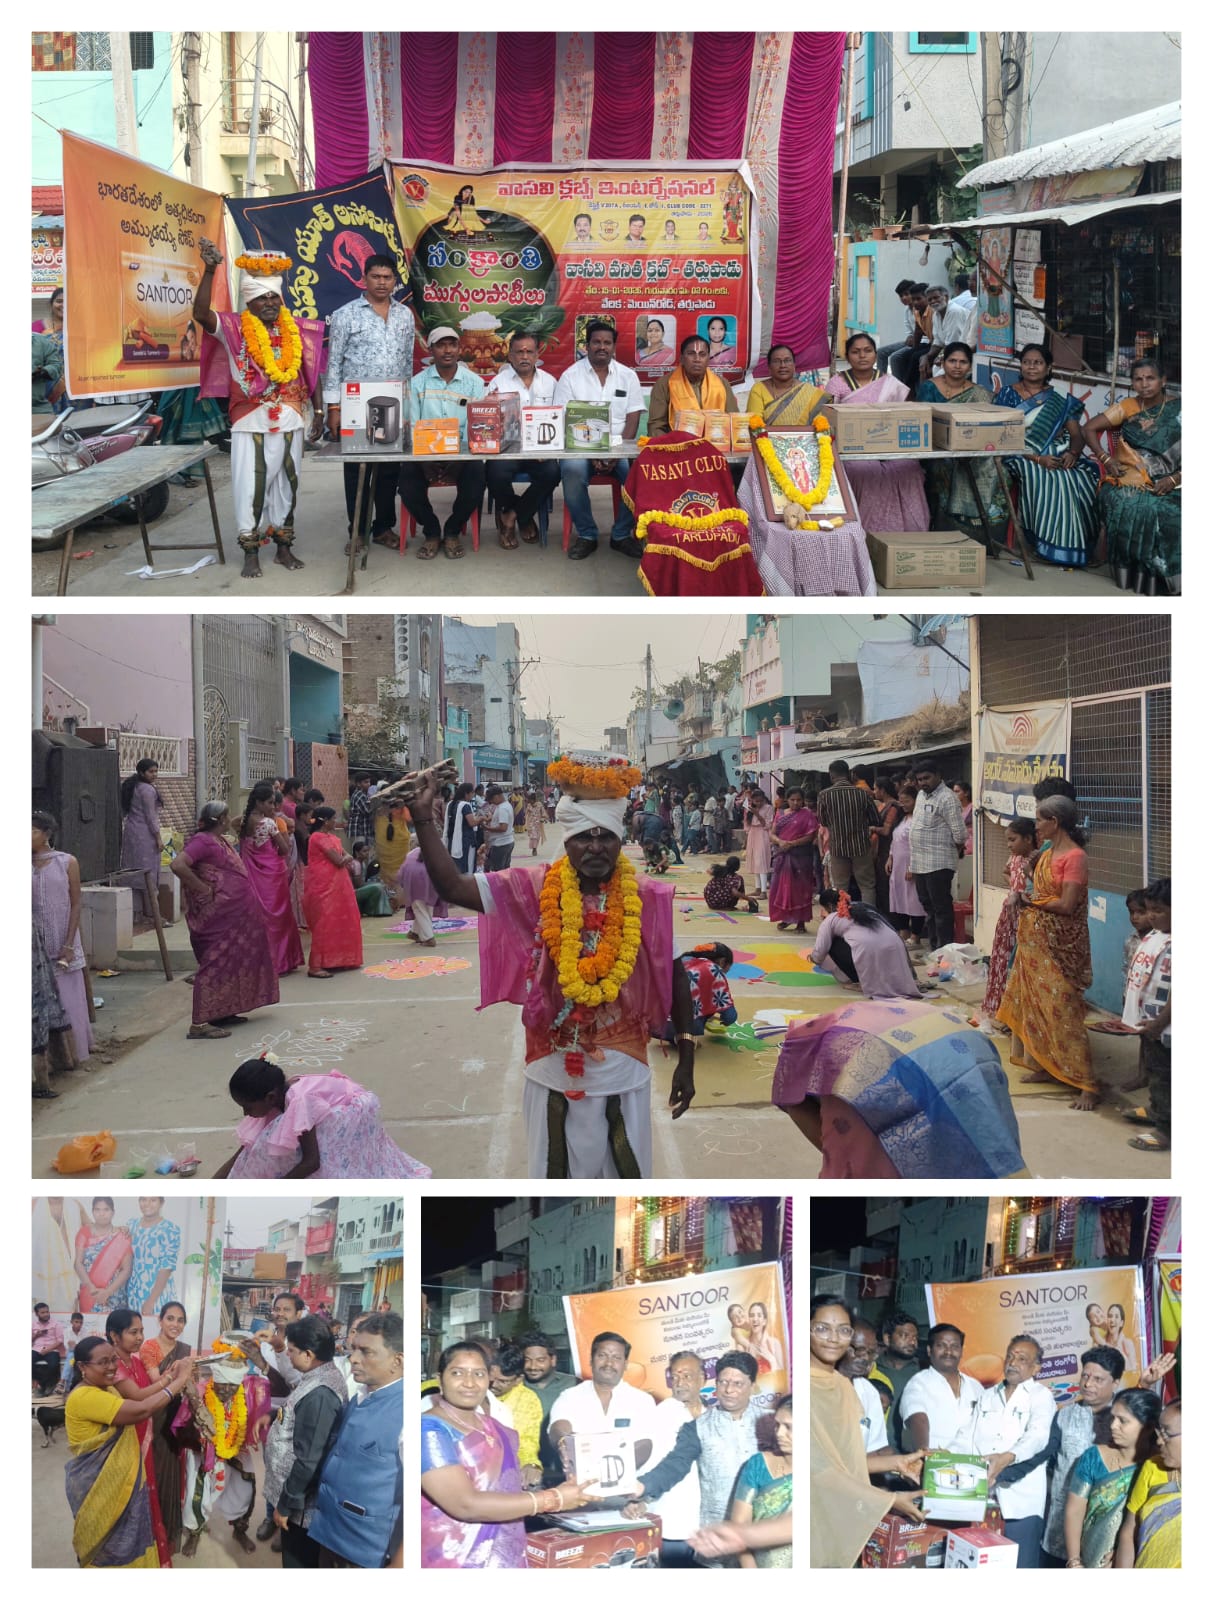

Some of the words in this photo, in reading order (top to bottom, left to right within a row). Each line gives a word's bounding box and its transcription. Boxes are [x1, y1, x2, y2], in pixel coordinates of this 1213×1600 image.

[497, 180, 555, 196] వాసవి
[558, 177, 594, 201] క్లబ్స్
[597, 176, 716, 201] ఇంటర్నేషనల్
[97, 181, 162, 212] భారతదేశంలో
[165, 202, 206, 226] అత్యధికంగా
[120, 218, 177, 252] అమ్ముడయ్యే
[177, 228, 195, 248] సోప్
[427, 241, 542, 278] సంక్రాంతి
[565, 258, 605, 279] వాసవి
[608, 260, 643, 279] వనిత
[645, 258, 671, 283] క్లబ్
[682, 260, 742, 283] తర్లుపాడు
[136, 282, 193, 305] SANTOOR
[424, 279, 545, 311] ముగ్గులపోటీలు
[677, 299, 716, 311] తర్లుపాడు
[640, 459, 693, 481] VASAVI
[638, 1286, 730, 1316] SANTOOR
[999, 1285, 1089, 1309] SANTOOR
